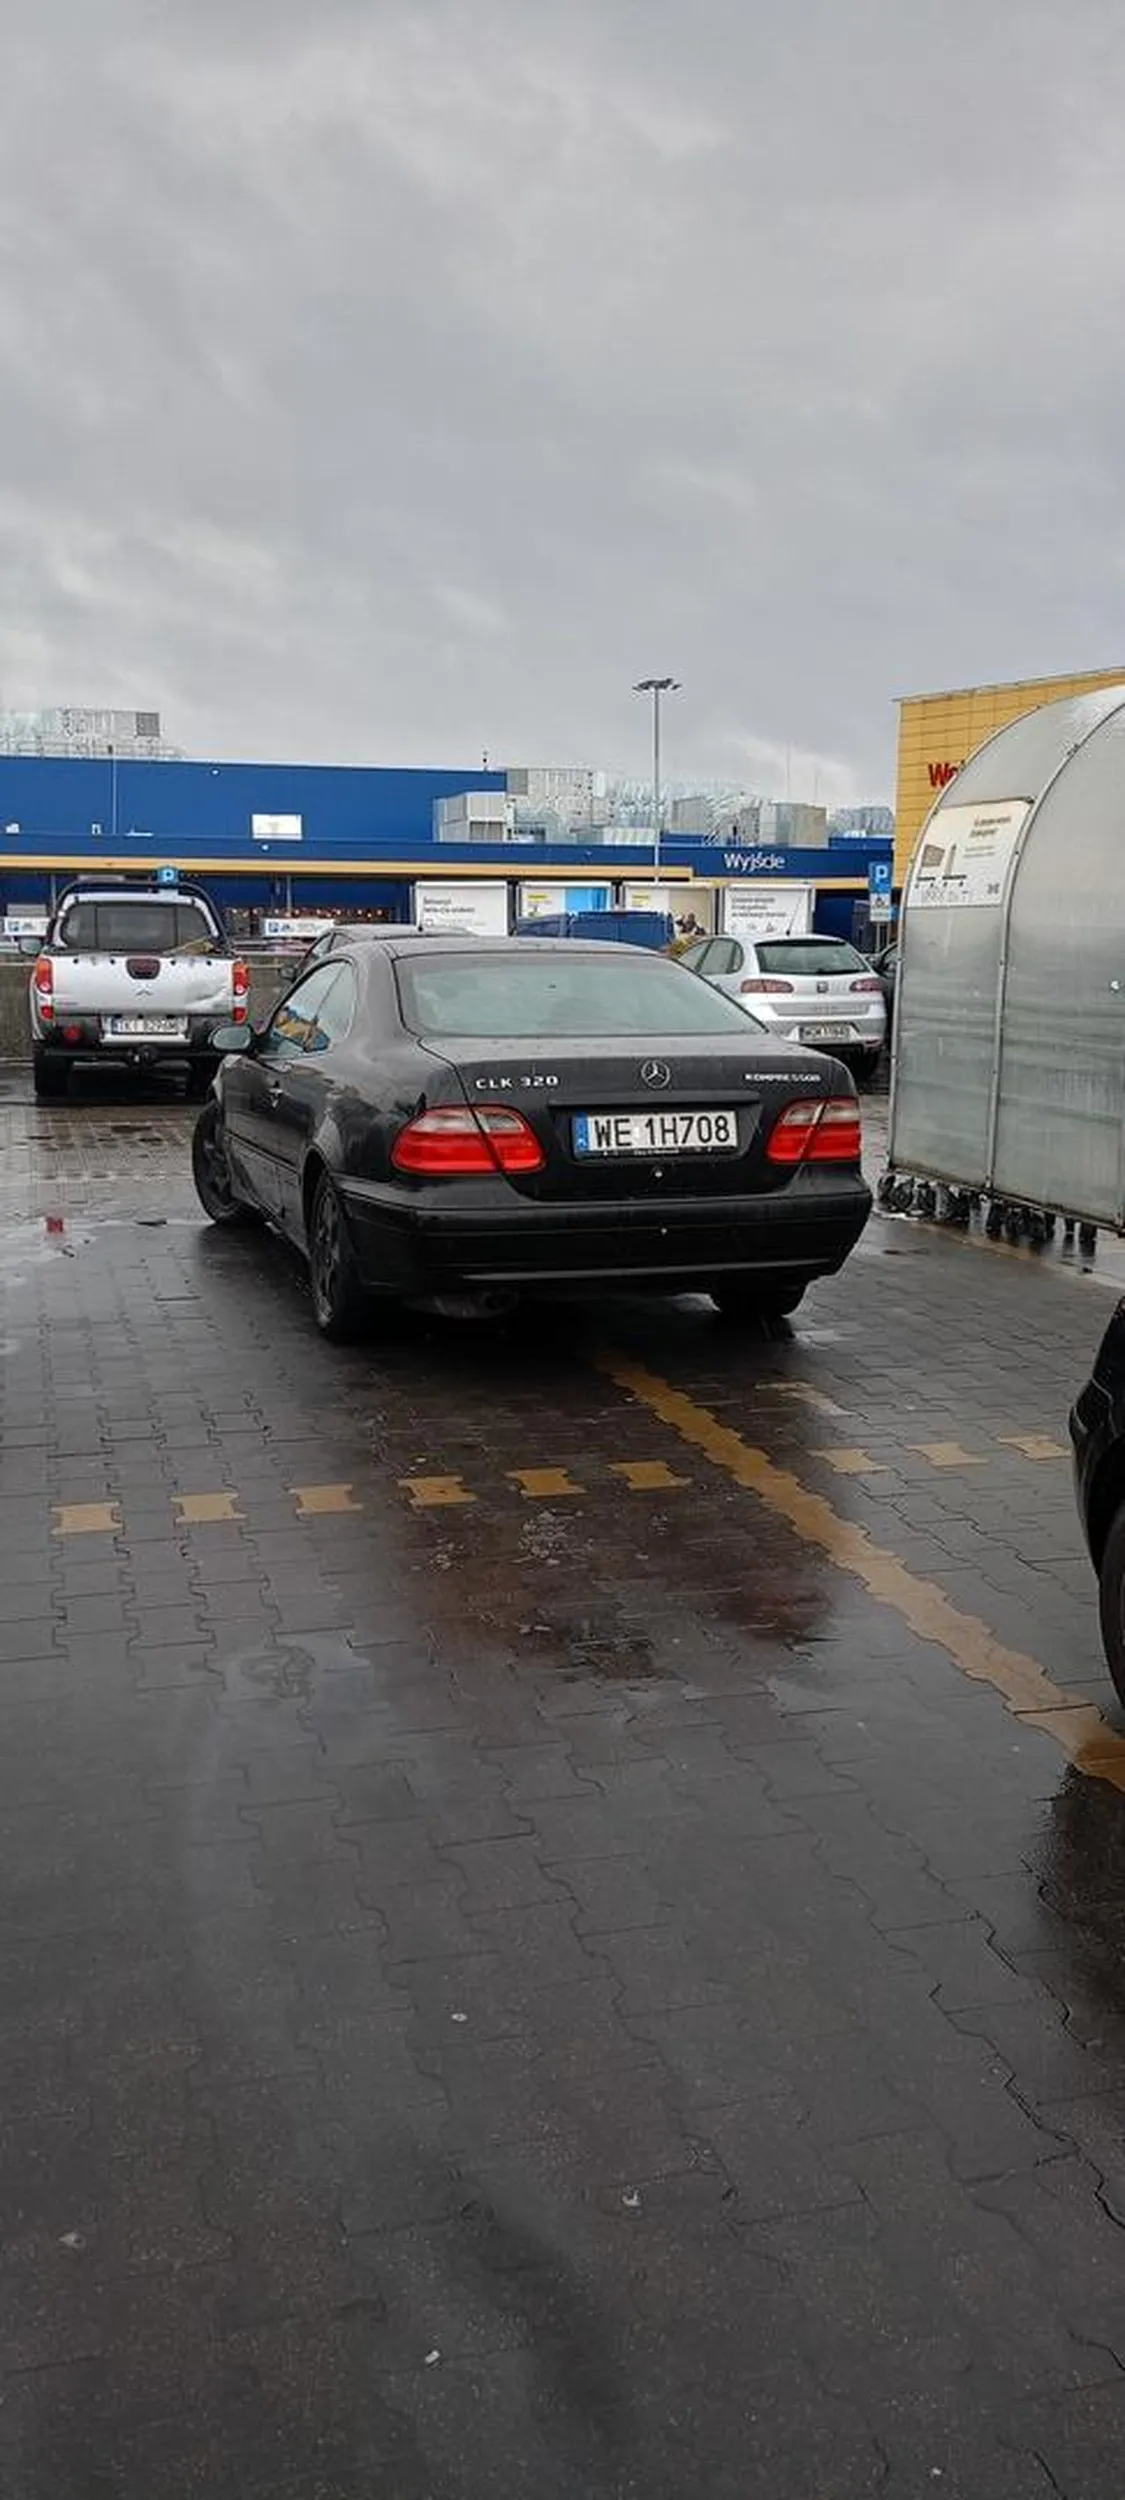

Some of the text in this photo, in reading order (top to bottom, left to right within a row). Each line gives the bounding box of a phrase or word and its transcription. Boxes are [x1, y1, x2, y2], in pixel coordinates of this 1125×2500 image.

[724, 852, 785, 872] Wyjście
[475, 1075, 559, 1090] CLK 320
[745, 1073, 821, 1082] KOMPRESSOR
[594, 1115, 730, 1148] WE 1H708
